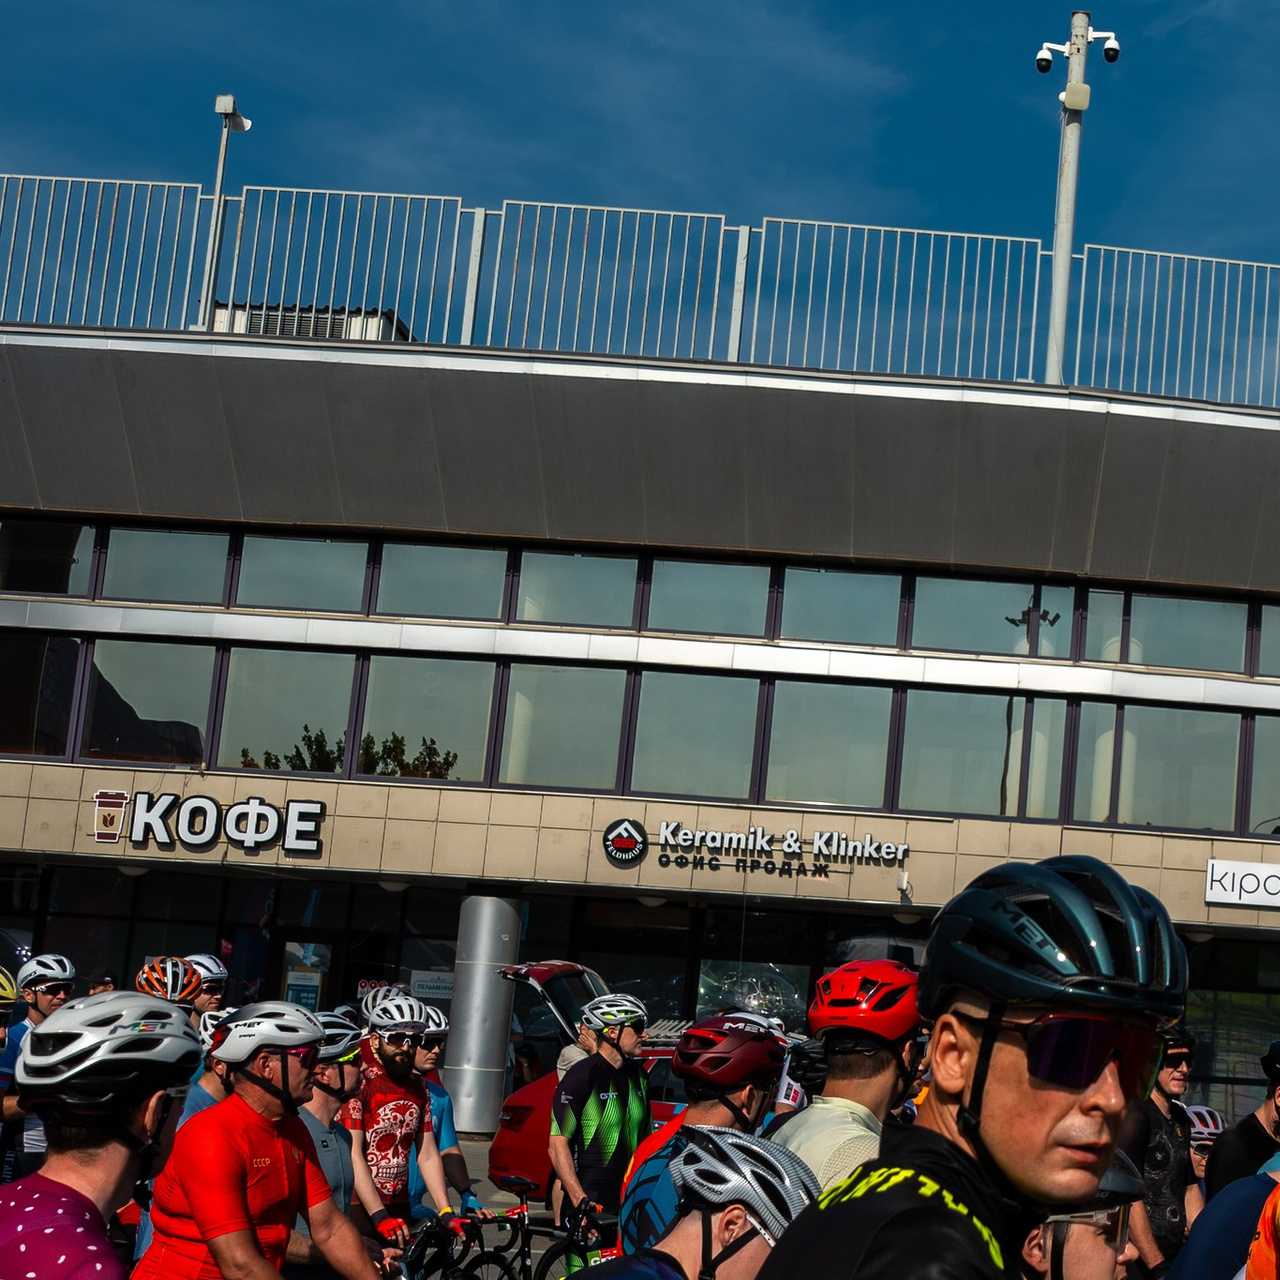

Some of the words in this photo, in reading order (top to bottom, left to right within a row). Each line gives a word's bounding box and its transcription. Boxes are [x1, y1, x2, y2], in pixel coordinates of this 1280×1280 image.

[129, 791, 326, 857] КОФЕ
[605, 841, 643, 860] FELDHAUS
[659, 821, 774, 853] Keramik
[782, 827, 802, 854] &
[813, 831, 911, 861] Klinker
[657, 853, 721, 872] ОФИС
[735, 856, 830, 879] ПРОДАЖ
[990, 898, 1066, 952] MET
[109, 1021, 174, 1035] MET
[234, 1020, 264, 1029] MET
[723, 1022, 768, 1034] MET
